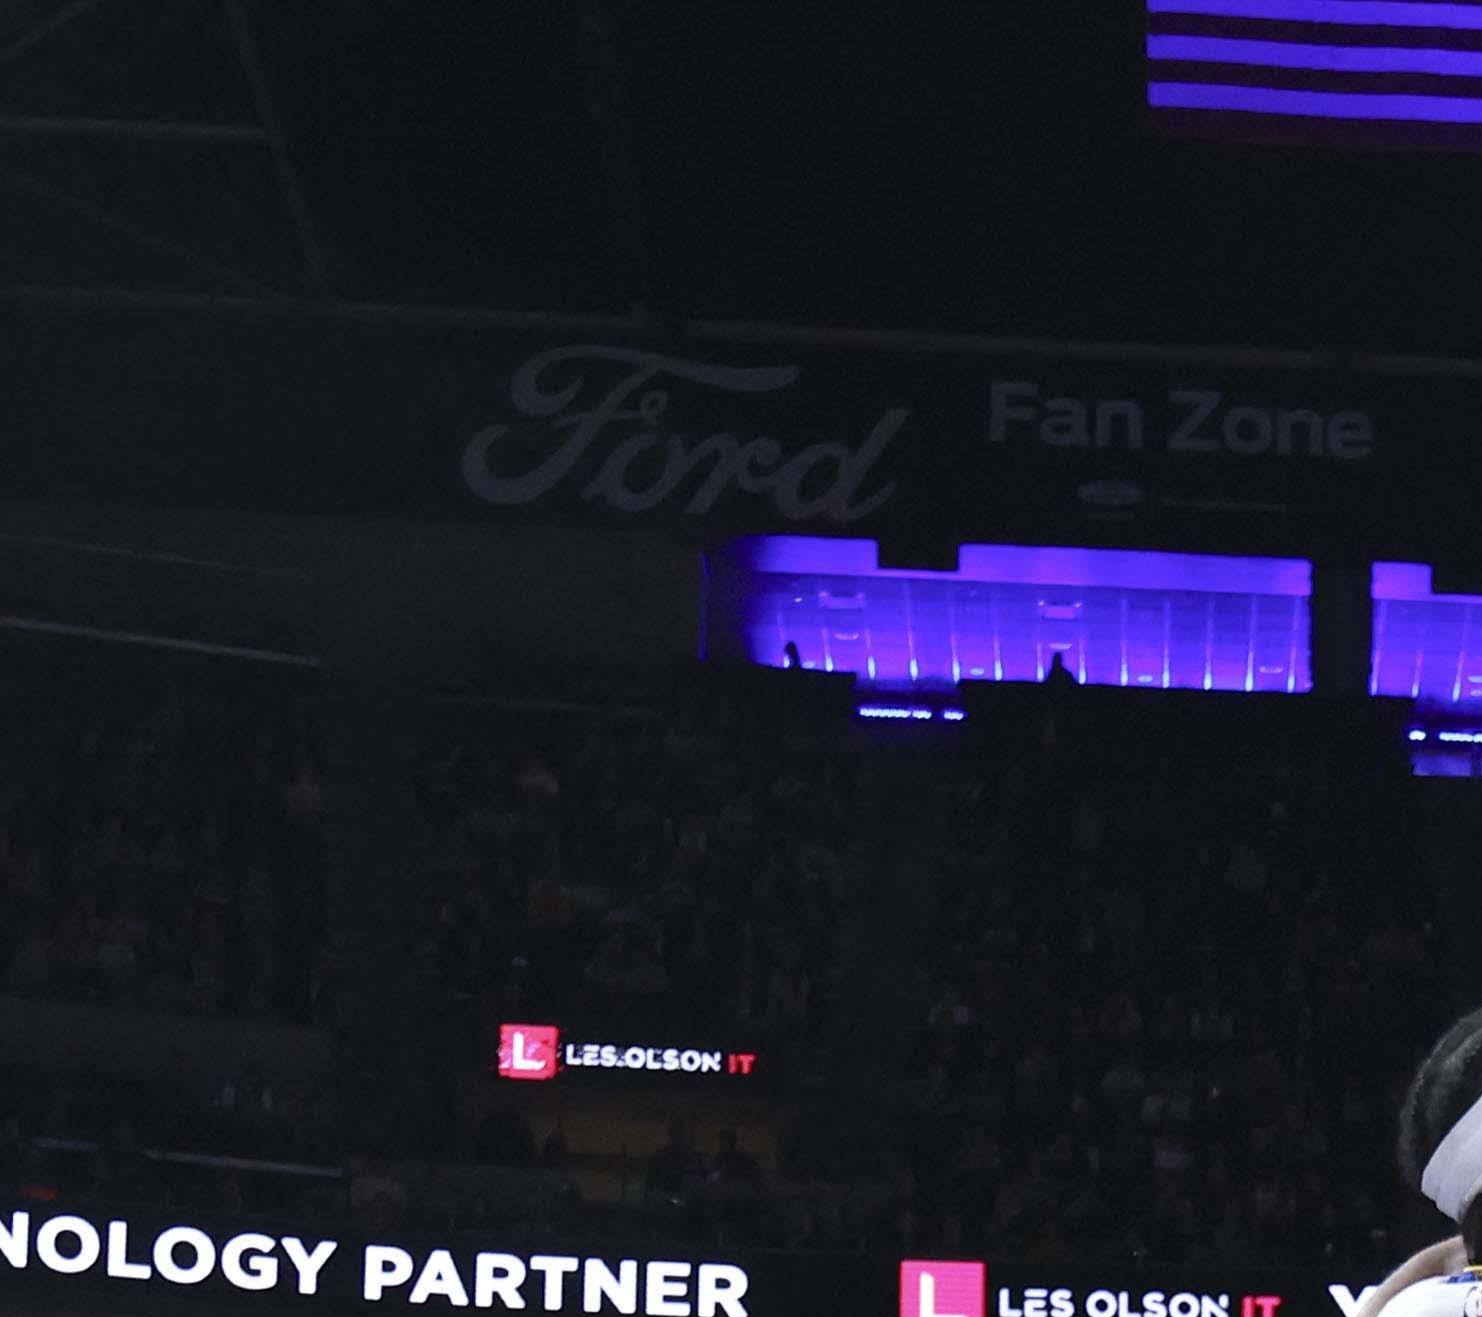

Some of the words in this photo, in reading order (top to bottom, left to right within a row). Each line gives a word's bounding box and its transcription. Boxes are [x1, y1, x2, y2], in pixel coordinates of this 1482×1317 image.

[460, 344, 911, 523] Ford
[984, 382, 1142, 450] Fan
[1165, 391, 1376, 460] Zone
[728, 1054, 756, 1074] IT
